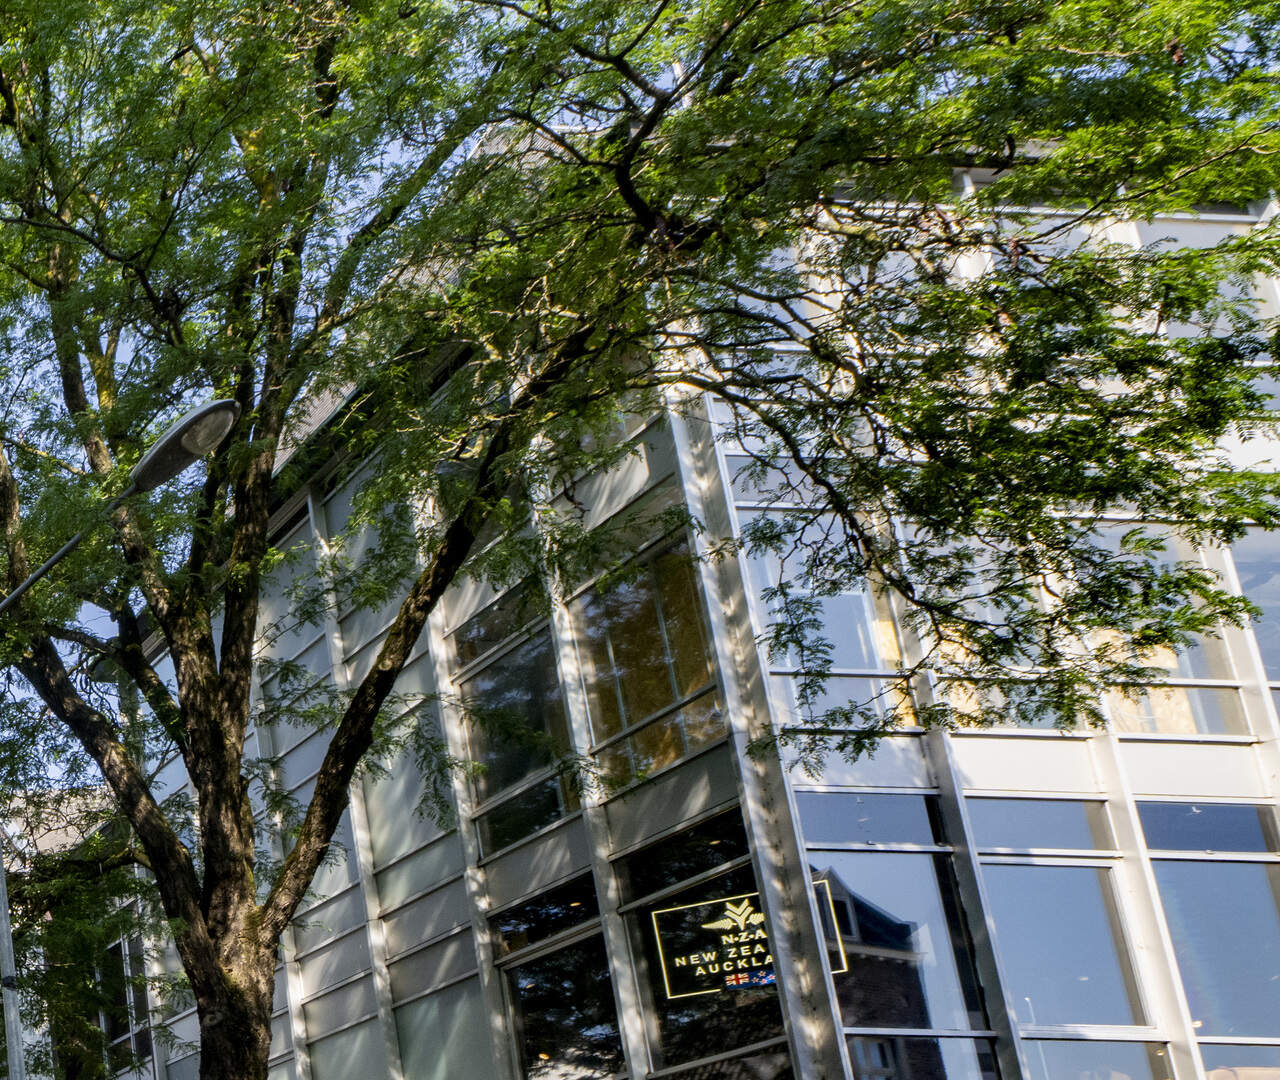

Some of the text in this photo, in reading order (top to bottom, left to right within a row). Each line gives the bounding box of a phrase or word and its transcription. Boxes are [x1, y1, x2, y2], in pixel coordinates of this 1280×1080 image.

[675, 944, 766, 967] NEW ZEA
[695, 954, 774, 976] AUCKLA
